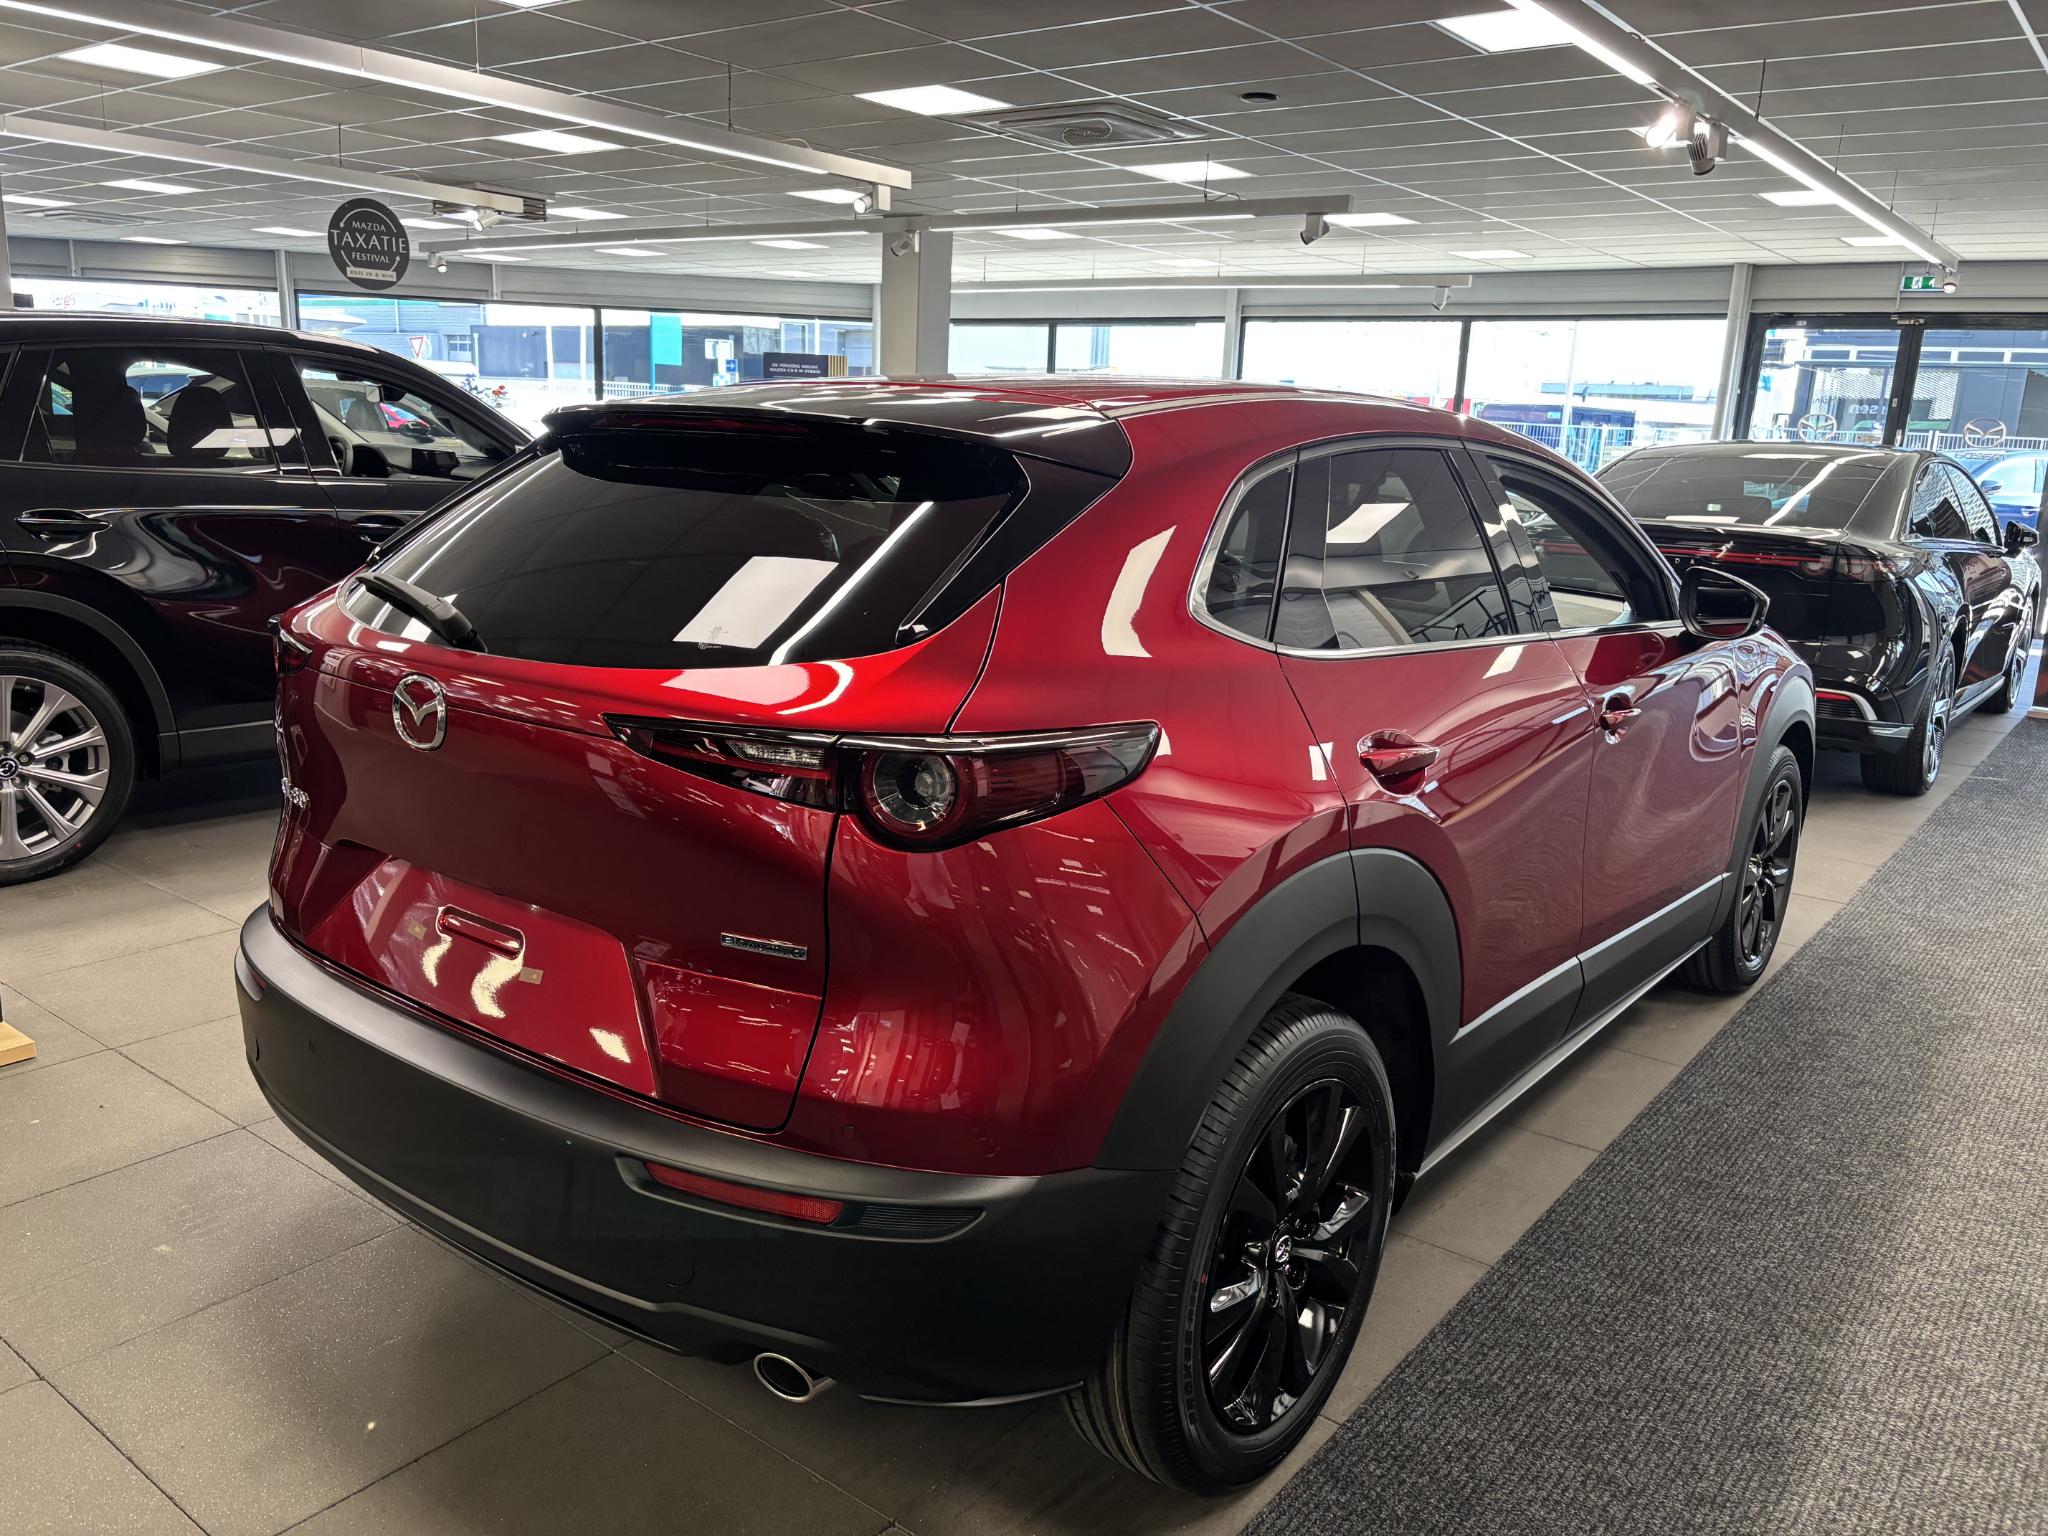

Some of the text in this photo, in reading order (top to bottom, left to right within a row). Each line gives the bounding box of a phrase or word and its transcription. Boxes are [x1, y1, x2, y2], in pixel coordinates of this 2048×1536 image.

[352, 221, 386, 232] MAZDA
[330, 230, 407, 253] TAXATIE
[352, 252, 389, 263] FESTIVAL
